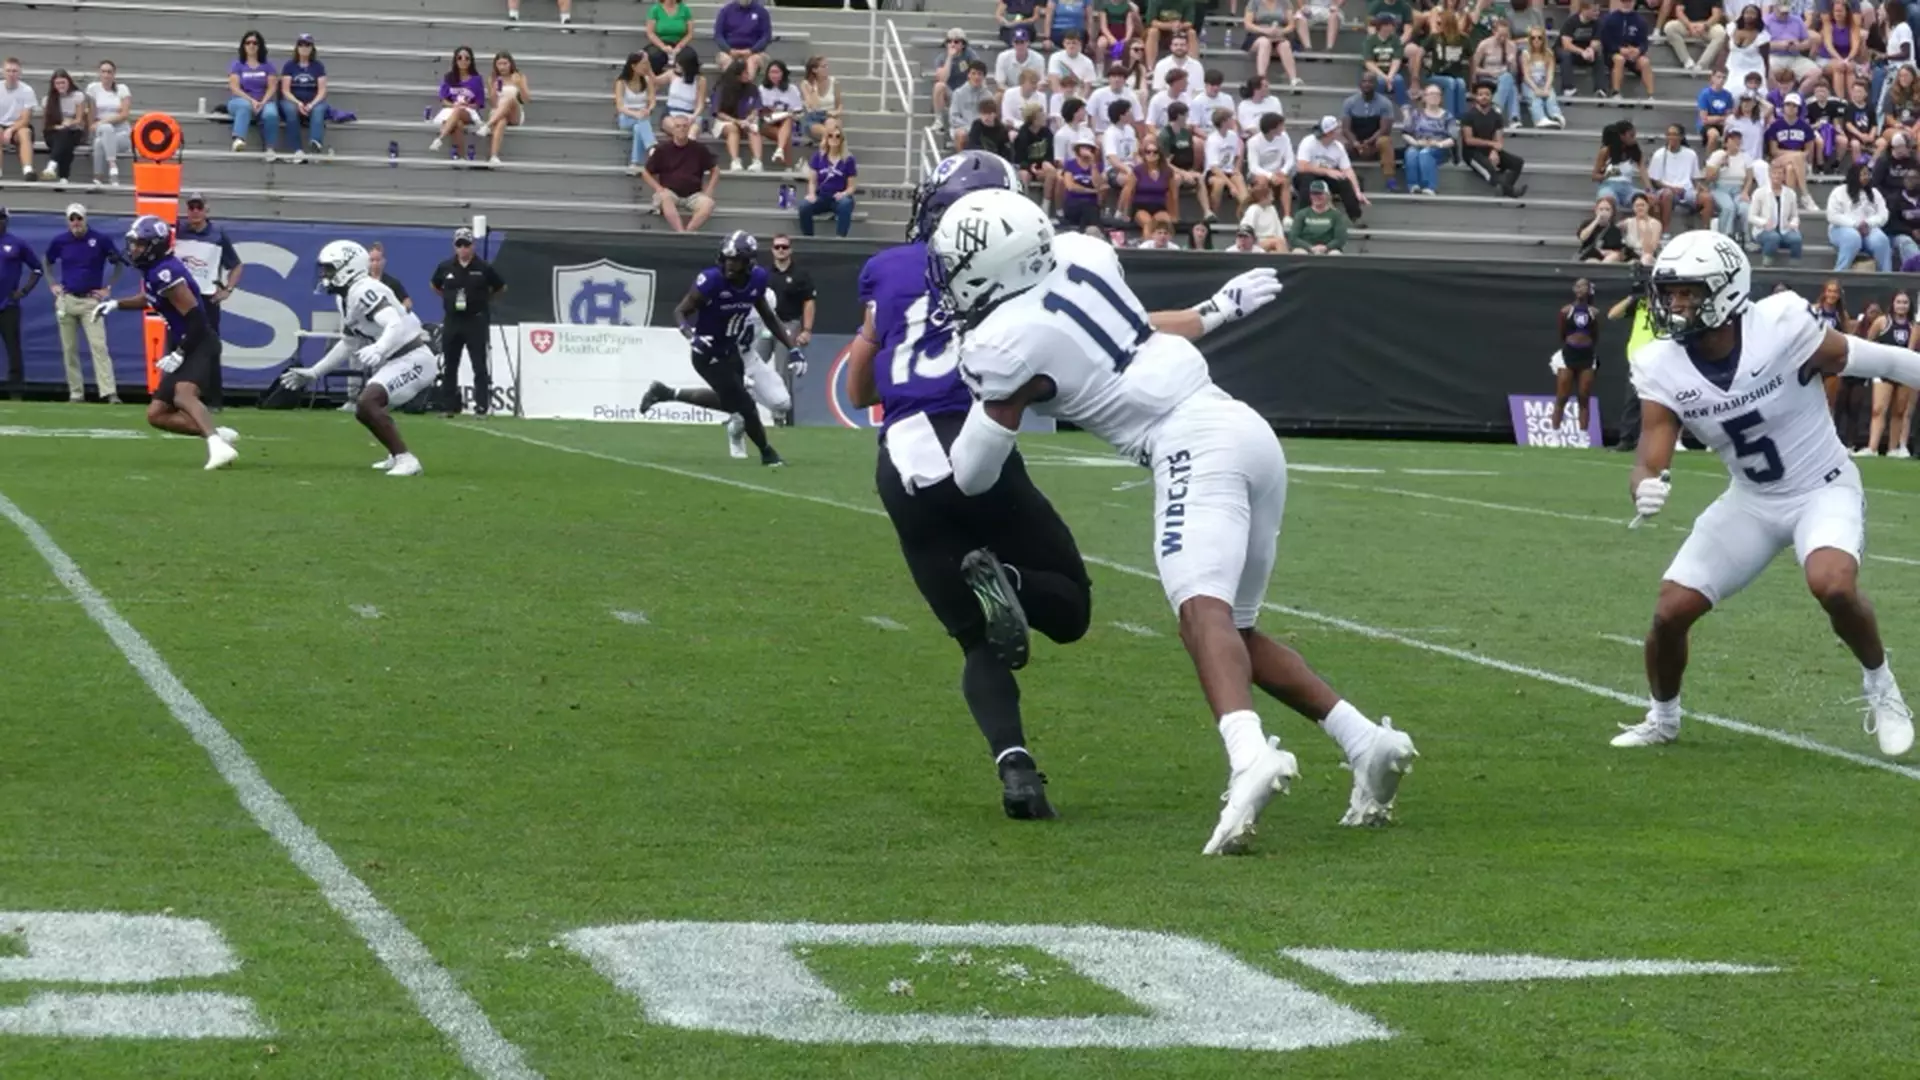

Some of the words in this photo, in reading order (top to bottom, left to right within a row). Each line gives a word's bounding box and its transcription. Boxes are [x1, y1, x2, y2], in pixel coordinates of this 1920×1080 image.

[360, 288, 378, 308] 10
[1043, 263, 1155, 376] 11
[593, 404, 714, 423] Point2Health
[1683, 407, 1709, 419] NEW
[1713, 374, 1785, 415] HAMPSHIRE
[1721, 408, 1785, 484] 5
